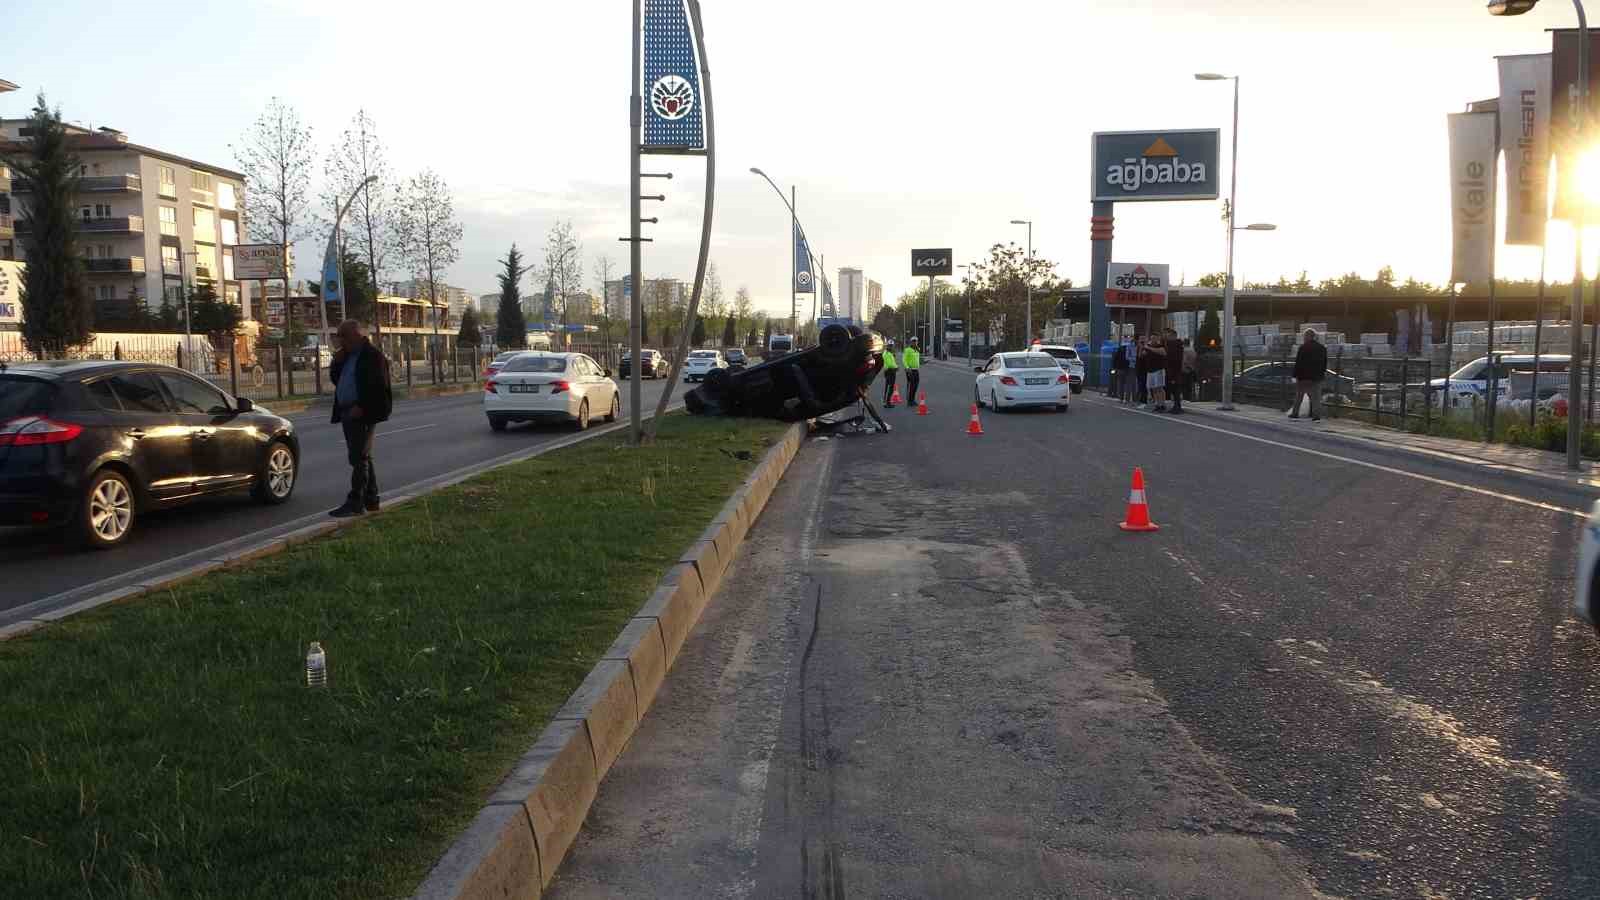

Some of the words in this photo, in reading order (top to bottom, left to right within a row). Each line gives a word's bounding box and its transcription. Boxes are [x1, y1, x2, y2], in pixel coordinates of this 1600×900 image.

[1106, 157, 1206, 191] ağbaba
[1459, 161, 1485, 224] Kale
[916, 257, 947, 267] KIA
[1115, 271, 1161, 289] ağbaba
